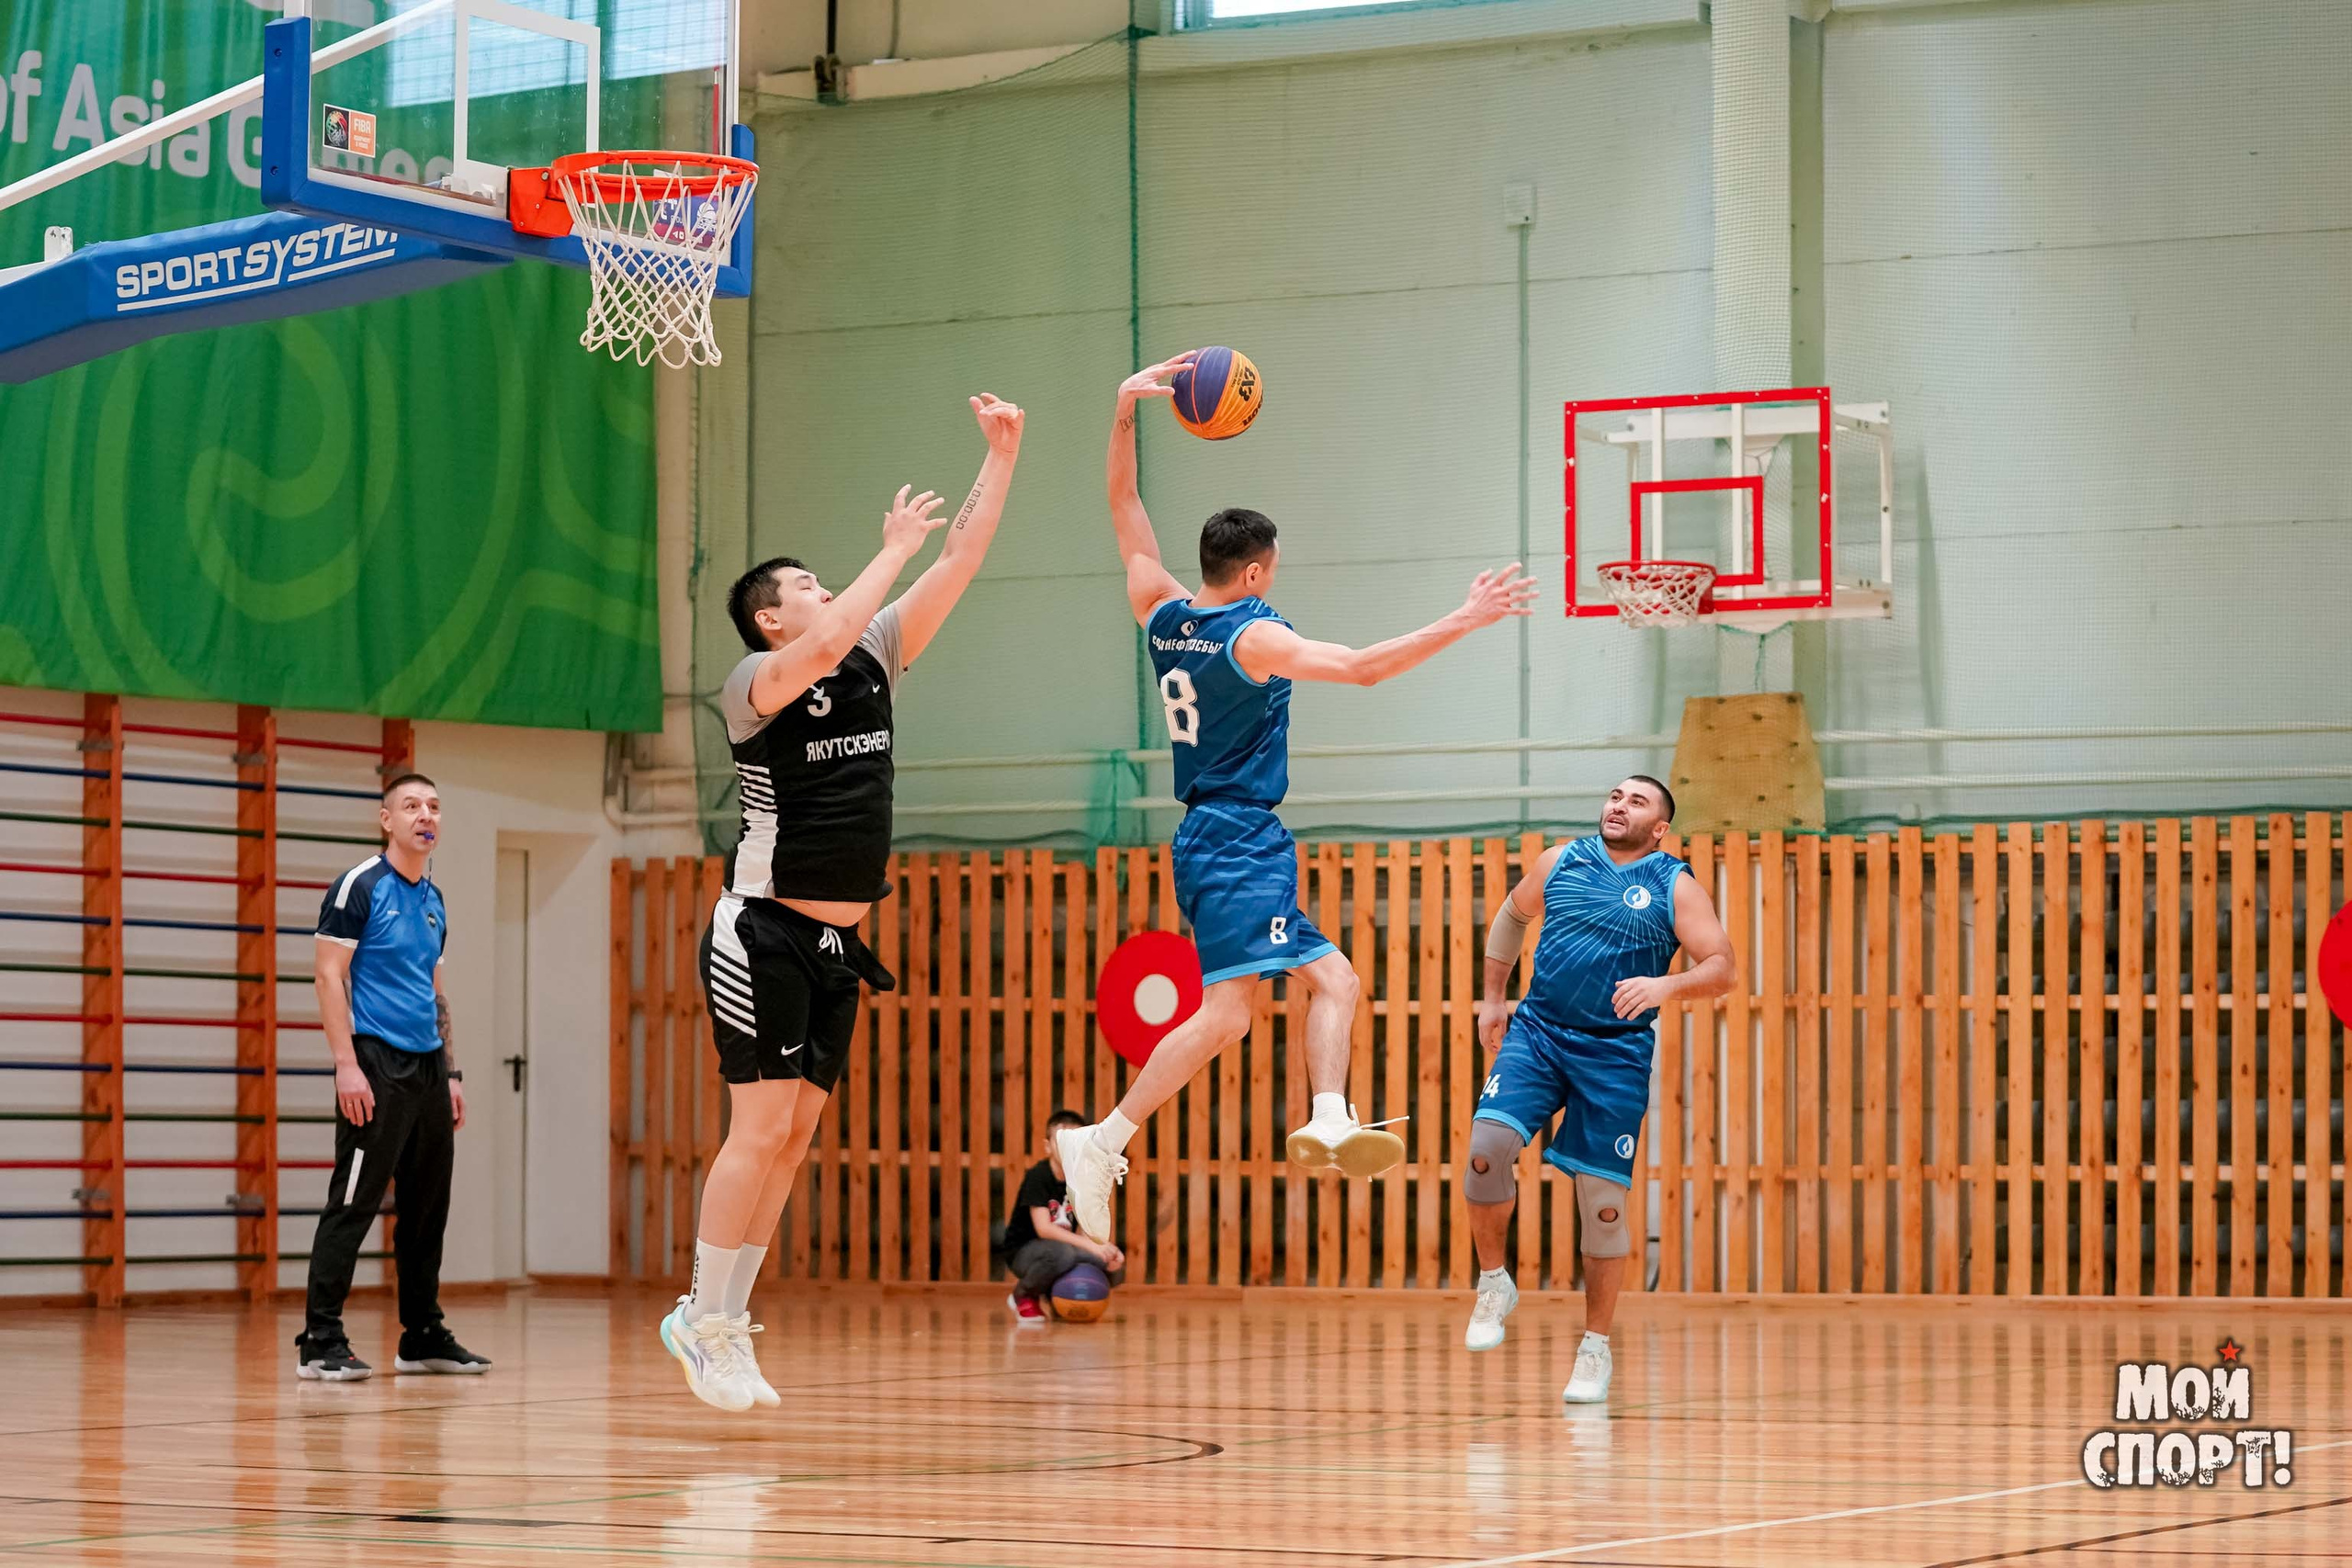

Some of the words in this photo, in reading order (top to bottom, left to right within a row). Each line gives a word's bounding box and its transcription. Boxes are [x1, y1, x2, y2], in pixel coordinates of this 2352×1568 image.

[0, 50, 42, 143] f
[52, 63, 210, 178] Asia
[354, 118, 371, 135] FIBA
[807, 684, 832, 717] 3
[1160, 667, 1201, 748] 8
[1270, 916, 1289, 945] 8
